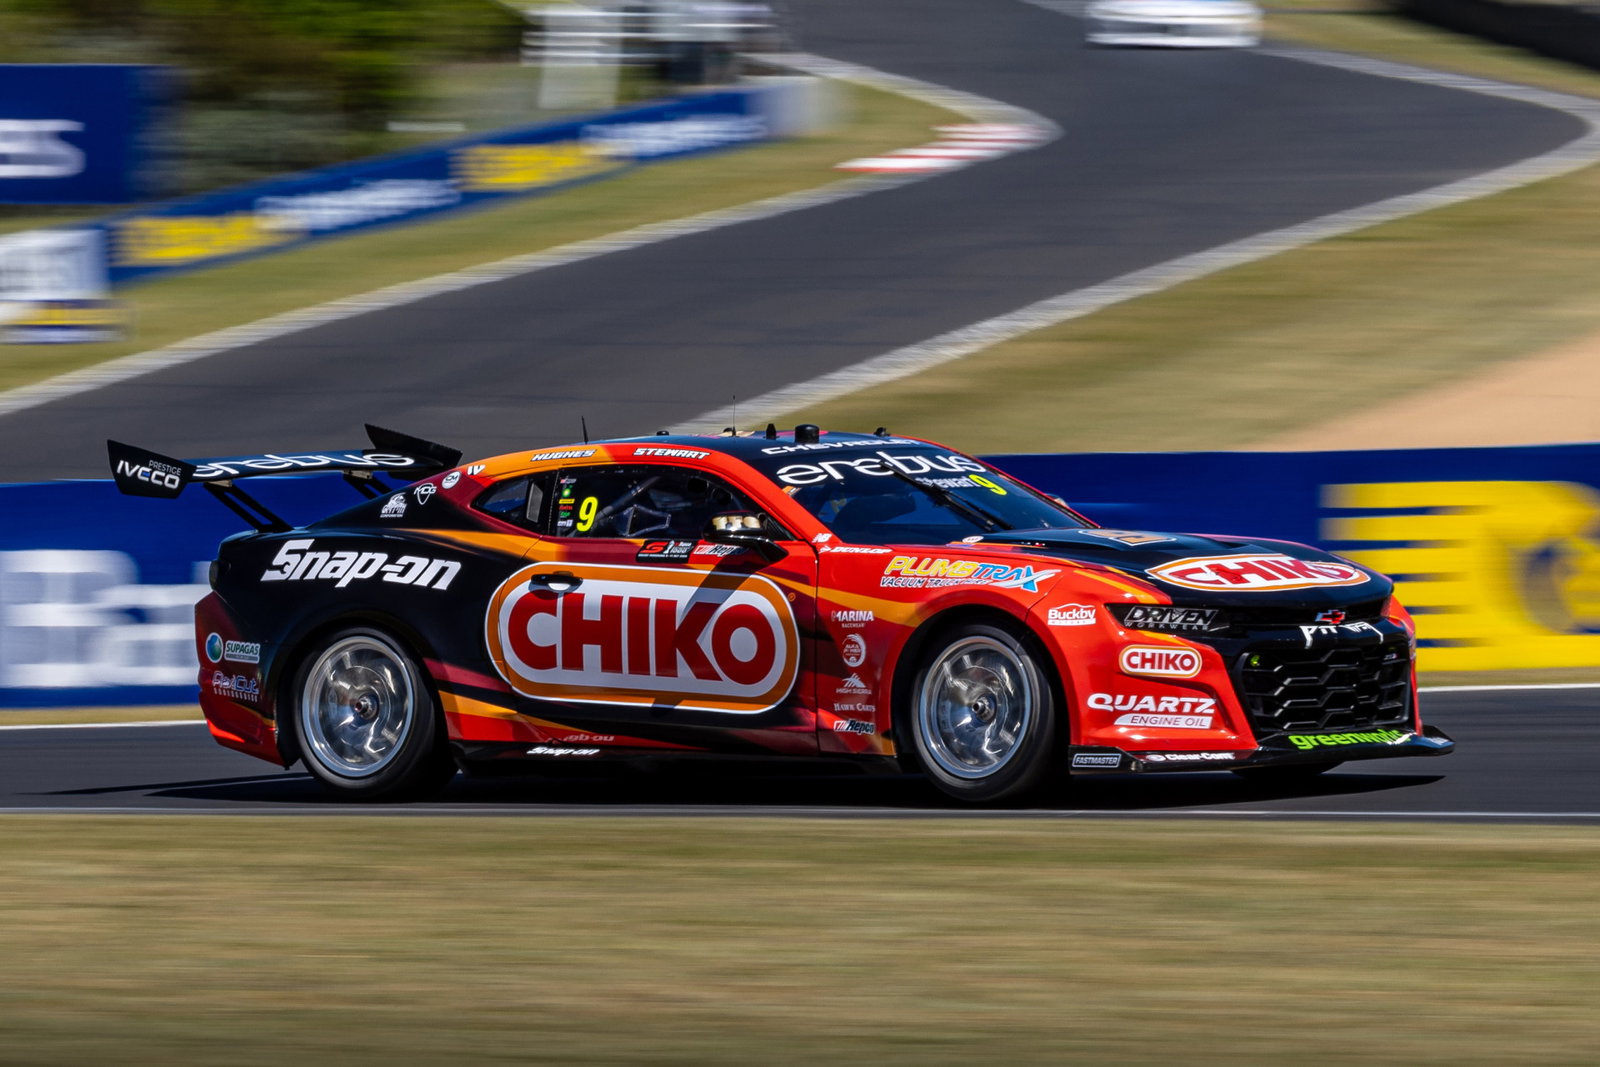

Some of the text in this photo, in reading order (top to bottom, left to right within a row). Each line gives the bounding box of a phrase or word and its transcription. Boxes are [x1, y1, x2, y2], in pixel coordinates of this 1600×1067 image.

[530, 449, 597, 461] HUGHES
[633, 447, 711, 460] STEWART
[761, 439, 921, 455] CHEVROLET
[149, 460, 182, 476] PRESTIGE
[192, 454, 415, 477] erebus
[777, 451, 987, 485] erebus
[117, 460, 180, 489] IVECO
[968, 474, 1008, 496] 9
[576, 496, 599, 532] 9
[829, 546, 893, 555] DUNLOP
[260, 538, 462, 591] Snap-on
[1168, 558, 1357, 586] CHIKO
[880, 576, 925, 588] VACUUM
[926, 577, 961, 588] TRUCK
[1048, 608, 1096, 620] Buckby
[1127, 607, 1215, 624] DRIVEN
[1124, 621, 1209, 631] WORKWEAR
[507, 588, 776, 686] CHIKO
[226, 642, 259, 656] SUPAGAS
[1125, 651, 1196, 671] CHIKO
[1086, 692, 1217, 714] QUARTZ
[846, 719, 875, 735] Repco
[1130, 715, 1206, 727] ENGINE OIL
[1075, 756, 1118, 765] FASTMASTER
